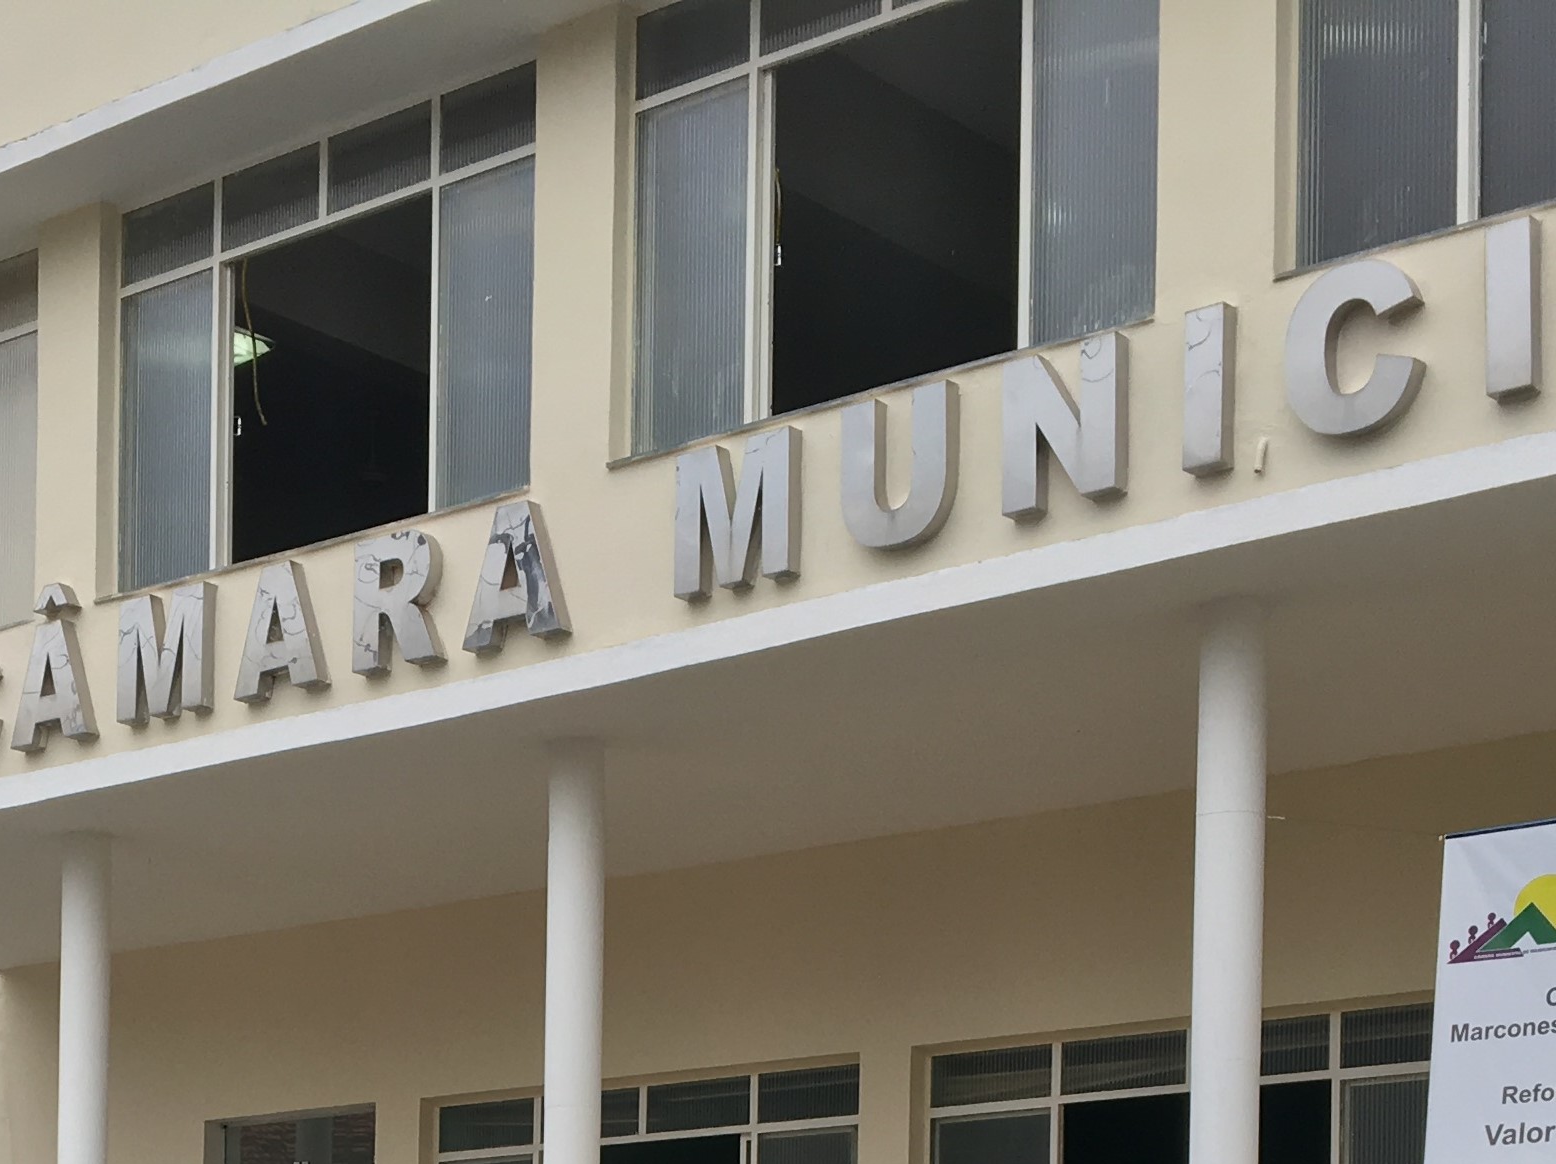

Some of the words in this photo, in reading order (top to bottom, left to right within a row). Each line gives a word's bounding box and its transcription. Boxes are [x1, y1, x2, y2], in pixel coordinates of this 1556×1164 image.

[674, 214, 1541, 601] MUNICI
[1501, 1082, 1555, 1105] Refo
[1484, 1121, 1556, 1146] Valor
